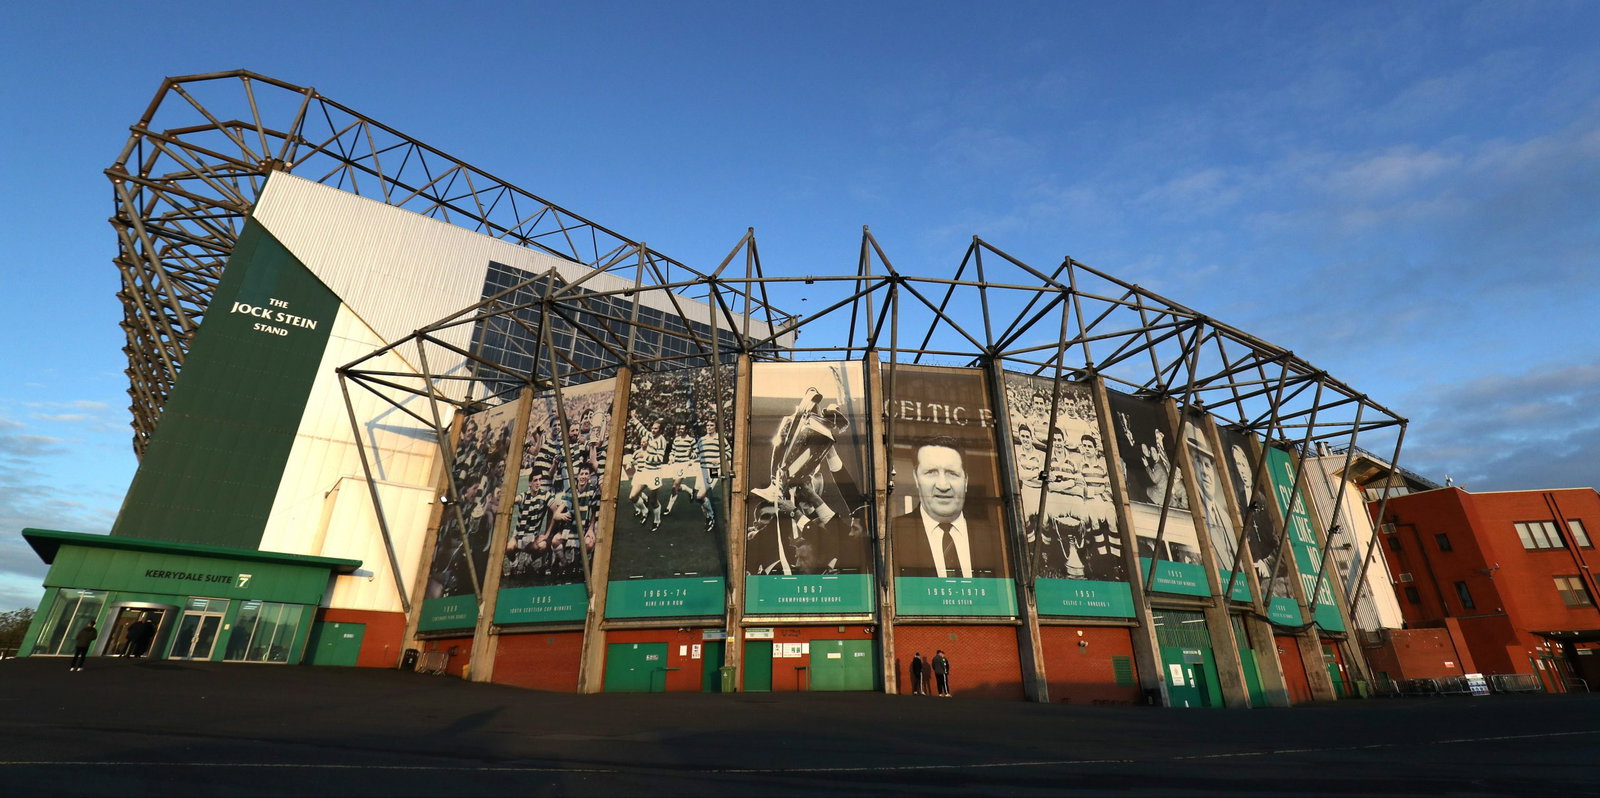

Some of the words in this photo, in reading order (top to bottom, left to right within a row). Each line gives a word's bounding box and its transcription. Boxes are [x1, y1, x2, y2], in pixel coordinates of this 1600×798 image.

[269, 298, 289, 309] THE
[230, 302, 273, 320] JOCK
[275, 312, 318, 330] STEIN
[253, 322, 288, 336] STAND
[884, 398, 968, 426] CELTIC
[654, 476, 660, 486] 8
[1284, 462, 1296, 486] A
[1292, 514, 1315, 544] LIKE
[1306, 545, 1322, 574] NO
[145, 570, 204, 582] KERRYDALE
[204, 574, 232, 584] SUITE
[239, 577, 248, 587] 7
[644, 589, 688, 598] 1965-74
[797, 585, 824, 594] 1967
[928, 588, 986, 596] 1965-1978
